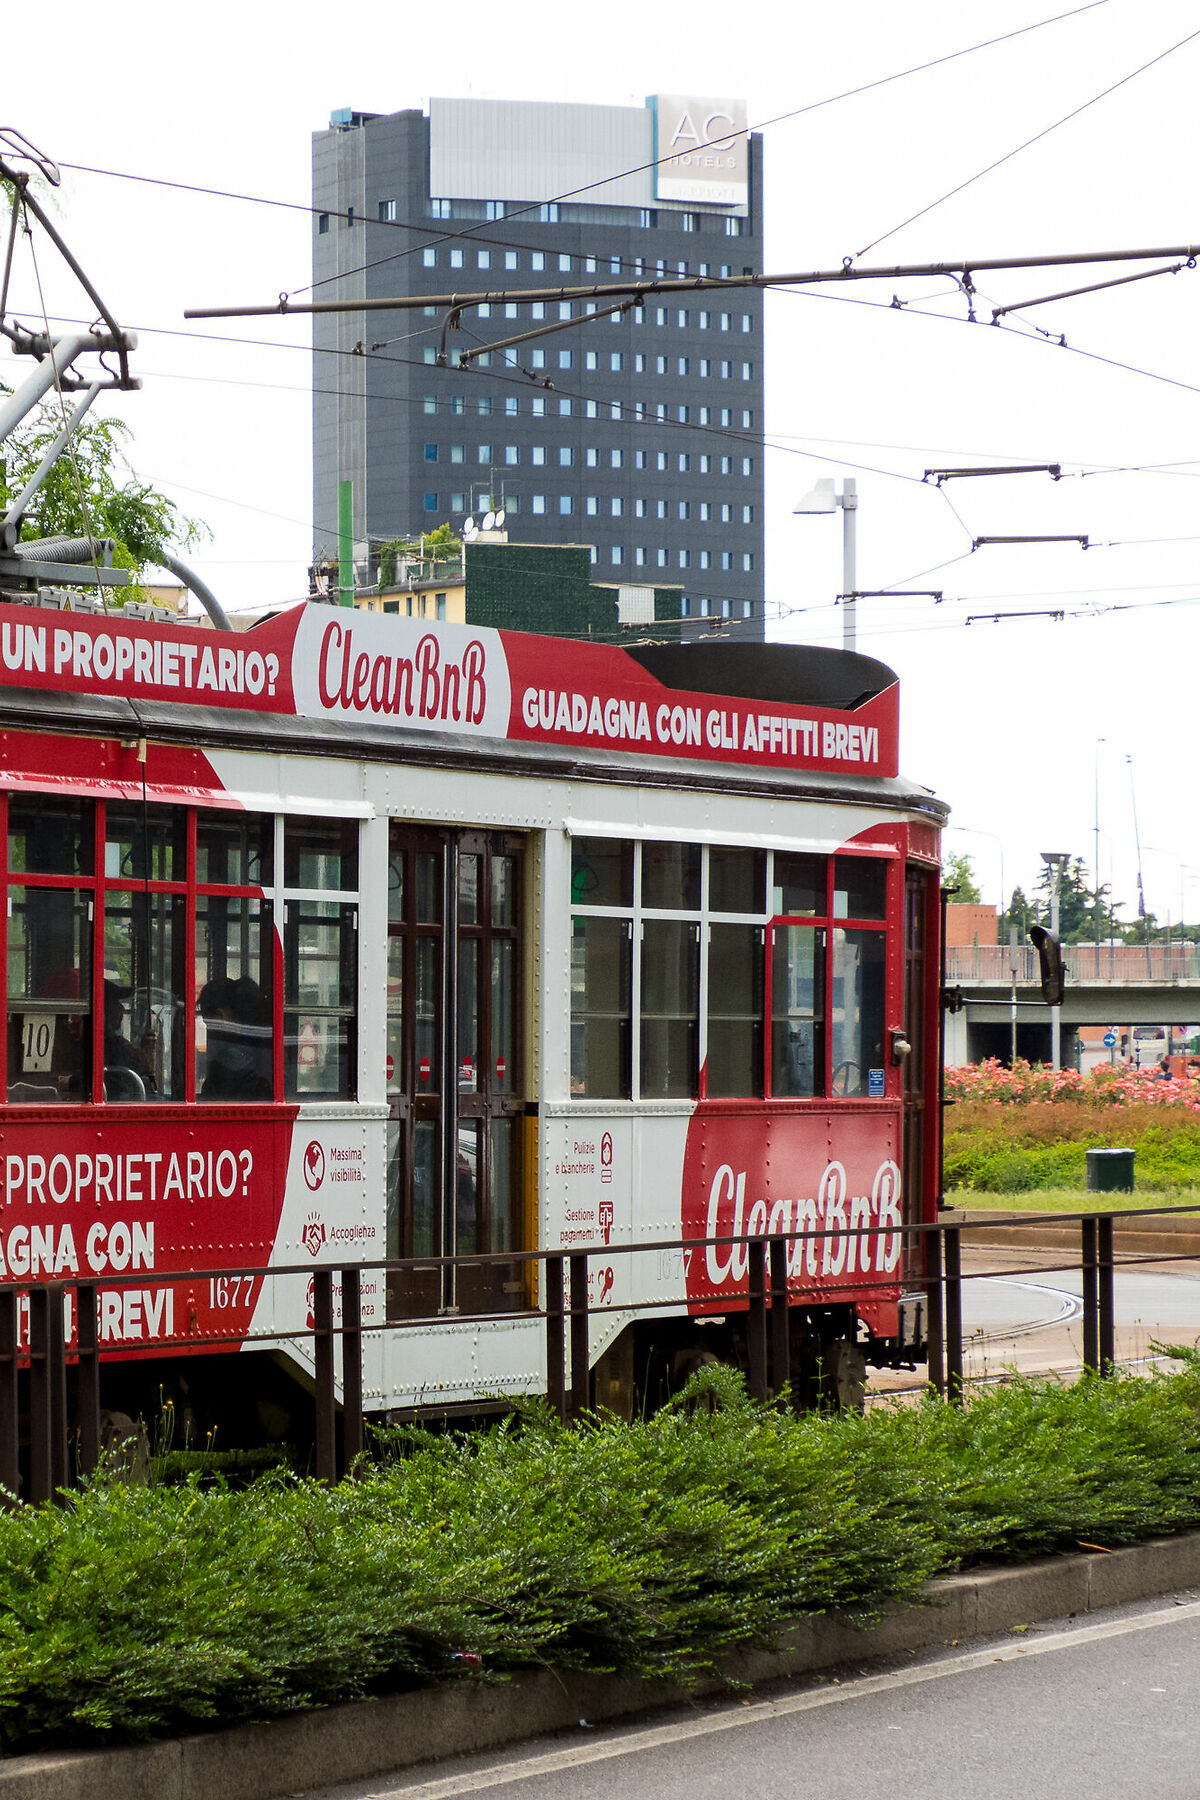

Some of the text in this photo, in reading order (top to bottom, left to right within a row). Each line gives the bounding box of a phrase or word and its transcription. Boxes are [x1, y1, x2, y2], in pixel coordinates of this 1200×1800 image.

[670, 111, 737, 151] AC
[670, 154, 737, 169] HOTELS
[2, 622, 46, 673] UN
[54, 628, 280, 697] PROPRIETARIO?
[318, 620, 487, 726] CleanBnB
[522, 687, 879, 763] GUADAGNA CON GLI AFFITTI BREVI
[26, 1023, 51, 1057] 10
[330, 1147, 362, 1160] Massima
[574, 1141, 596, 1154] Pulizie
[6, 1149, 253, 1205] PROPRIETARIO?
[330, 1168, 362, 1182] visibilità
[555, 1164, 560, 1174] e
[566, 1208, 595, 1221] Gestione
[86, 1221, 155, 1272] CON
[330, 1225, 376, 1241] Accoglienza
[209, 1275, 255, 1309] 1677
[96, 1287, 175, 1339] REVI
